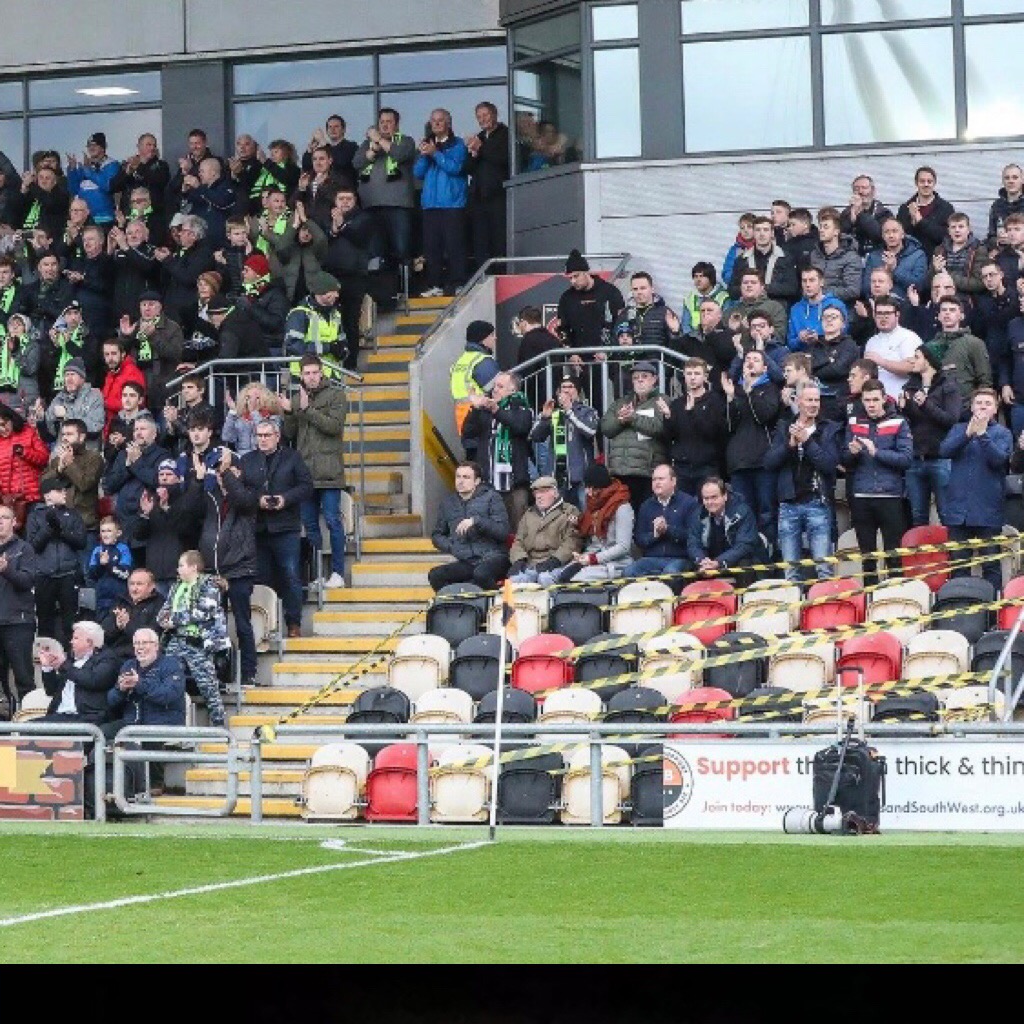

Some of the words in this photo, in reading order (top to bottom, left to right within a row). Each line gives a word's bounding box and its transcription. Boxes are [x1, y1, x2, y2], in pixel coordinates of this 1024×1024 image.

[697, 756, 791, 782] Support
[895, 755, 951, 776] thick
[957, 756, 975, 776] &
[702, 800, 728, 813] Join
